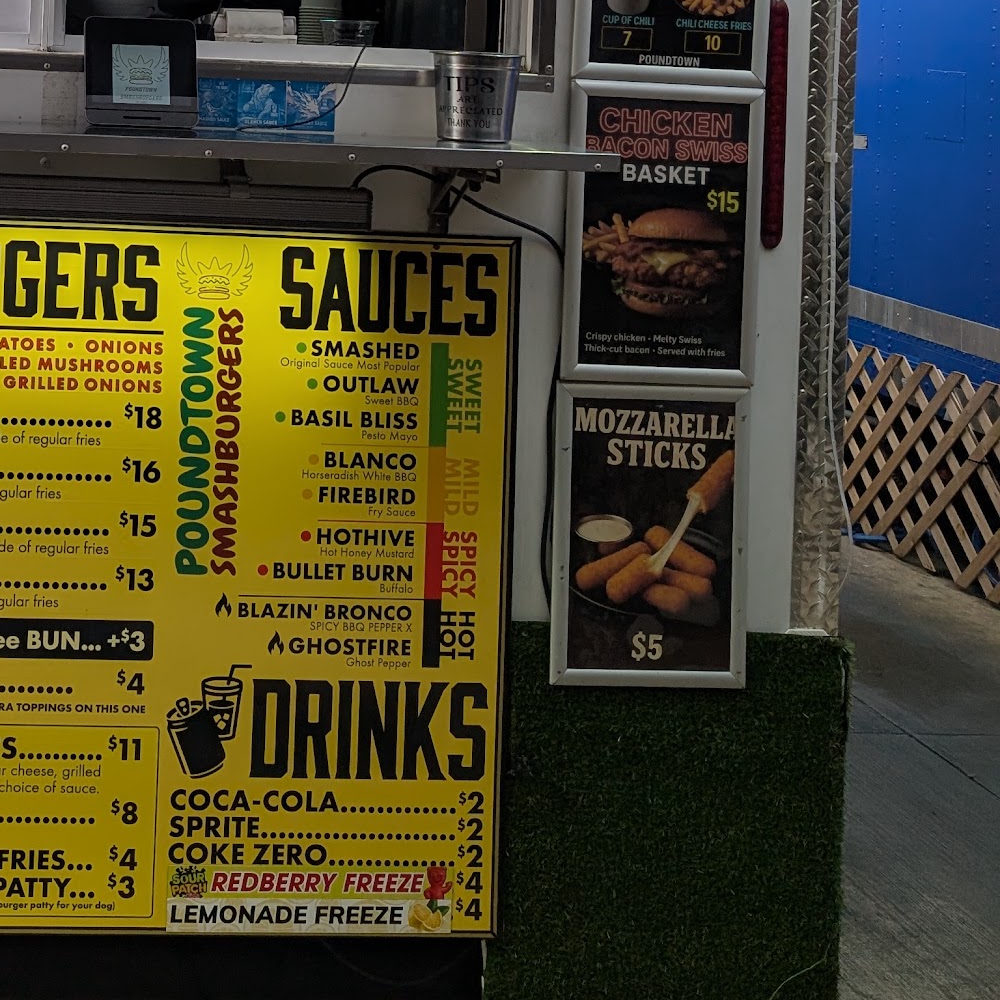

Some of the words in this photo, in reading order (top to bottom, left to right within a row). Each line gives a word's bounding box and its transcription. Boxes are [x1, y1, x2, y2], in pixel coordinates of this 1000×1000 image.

[603, 15, 619, 24] CUP
[621, 16, 631, 24] OF
[633, 16, 654, 25] CHILI
[676, 19, 697, 28] CHILI
[698, 20, 728, 29] CHEESE
[730, 21, 752, 30] FRIES
[623, 31, 632, 46] 7
[705, 35, 721, 50] 10
[639, 54, 700, 67] POUNDTOWN
[443, 76, 495, 93] TIPS
[447, 118, 470, 127] THANK
[473, 120, 490, 128] YOU
[599, 107, 732, 138] CHICKEN
[586, 135, 669, 160] BACON
[675, 140, 748, 163] SWISS
[623, 164, 710, 185] BASKET
[707, 189, 740, 213] $15
[279, 245, 499, 337] SAUCES
[85, 339, 164, 355] ONIONS
[586, 331, 612, 342] Crispy
[614, 332, 646, 342] chicken
[653, 334, 677, 344] Melty
[679, 335, 702, 344] Swiss
[311, 340, 420, 359] SMASHED
[584, 343, 623, 353] Thick-cut
[624, 344, 650, 354] bacon
[657, 346, 685, 356] Served
[687, 347, 706, 356] with
[707, 348, 725, 357] fries
[38, 358, 163, 374] MUSHROOMS
[280, 357, 320, 370] Original
[323, 359, 354, 369] Sauce
[357, 360, 381, 370] Most
[384, 361, 420, 373] Popular
[3, 375, 78, 390] GRILLED
[84, 378, 162, 394] ONIONS
[323, 376, 419, 394] OUTLAW
[124, 402, 162, 430] $18
[575, 406, 735, 440] MOZZARELLA
[13, 432, 25, 444] of
[29, 433, 73, 448] regular
[76, 434, 101, 446] fries
[174, 307, 215, 575] POUNDTOWN
[211, 307, 244, 576] SMASHBURGERS
[324, 451, 417, 470] BLANCO
[607, 438, 707, 470] STICKS
[459, 531, 478, 599] SPICY
[458, 611, 476, 660] HOT
[289, 637, 411, 656] GHOSTFIRE
[631, 631, 663, 661] $5
[346, 657, 373, 668] Ghost
[377, 657, 411, 670] Pepper
[249, 678, 488, 781] DRINKS
[210, 871, 338, 894] REDBERRY
[343, 872, 425, 894] FREEZE
[31, 902, 54, 911] patty
[72, 903, 93, 912] your
[95, 901, 115, 911] dog)
[169, 905, 307, 925] LEMONADE
[315, 905, 404, 926] FREEZE
